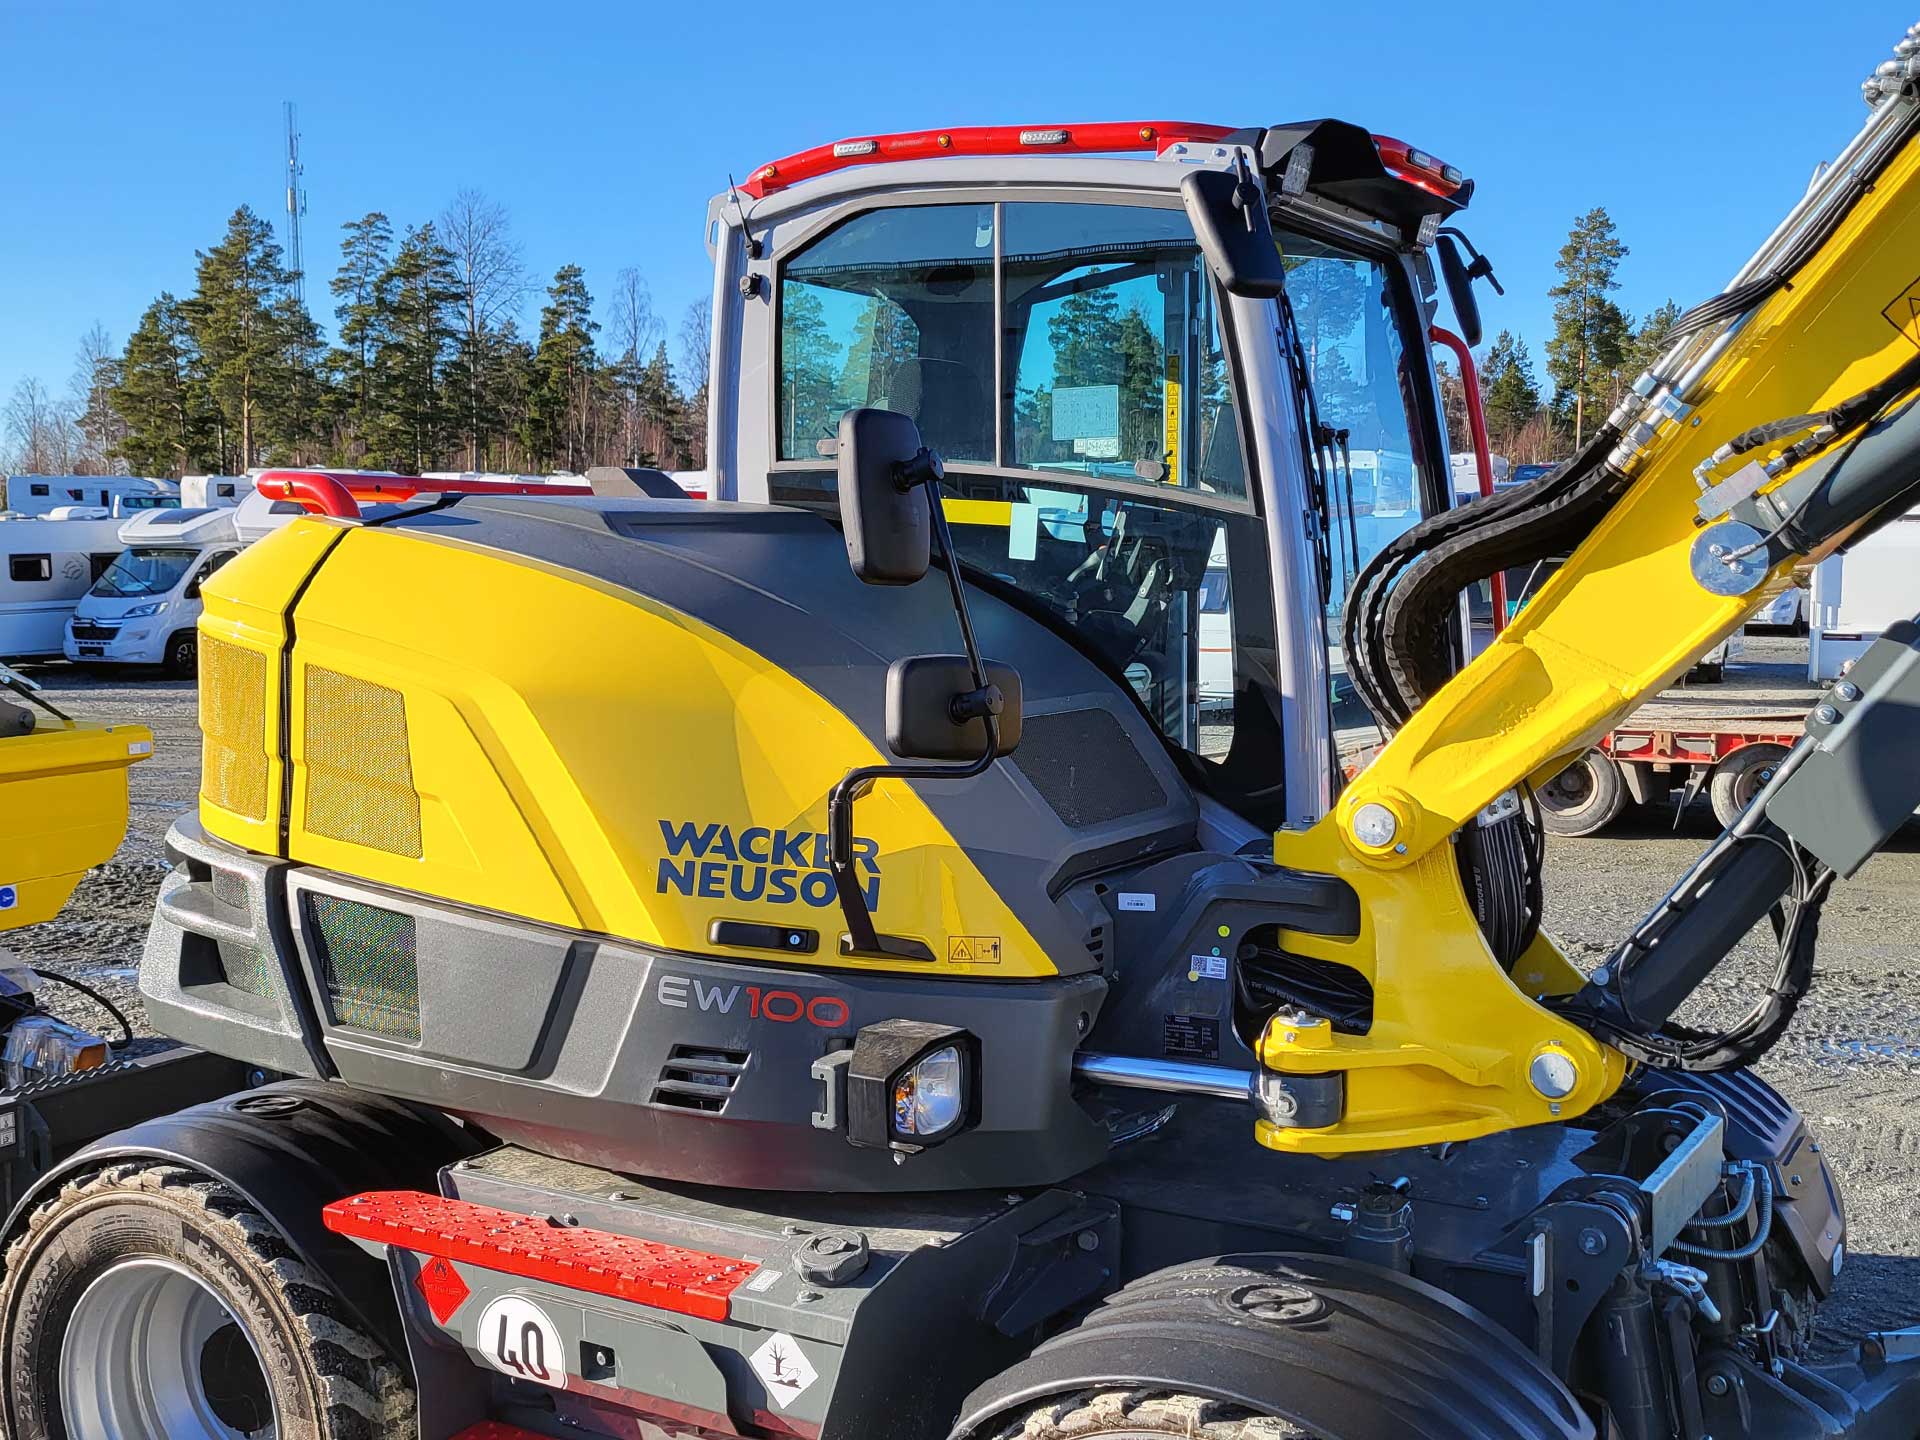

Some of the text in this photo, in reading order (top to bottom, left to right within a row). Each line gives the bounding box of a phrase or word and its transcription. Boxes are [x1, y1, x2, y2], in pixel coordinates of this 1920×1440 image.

[658, 820, 881, 874] WACKER
[657, 975, 849, 1028] EW100
[497, 1313, 550, 1380] 40
